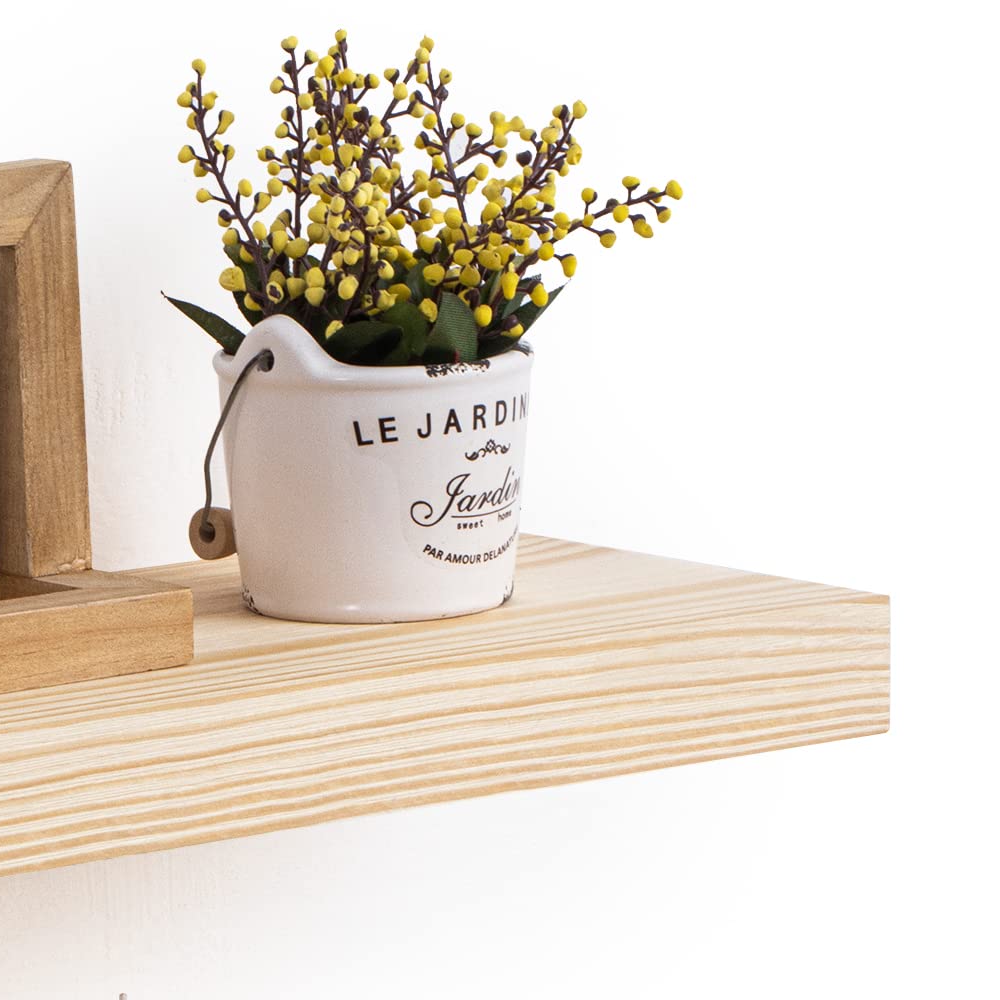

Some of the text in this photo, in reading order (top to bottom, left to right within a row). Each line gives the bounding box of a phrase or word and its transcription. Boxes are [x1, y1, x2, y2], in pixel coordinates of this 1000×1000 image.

[353, 417, 398, 446] LE
[410, 466, 520, 527] Jardin
[457, 519, 484, 530] sweet
[423, 544, 444, 560] PAR
[444, 553, 481, 564] AMOUR
